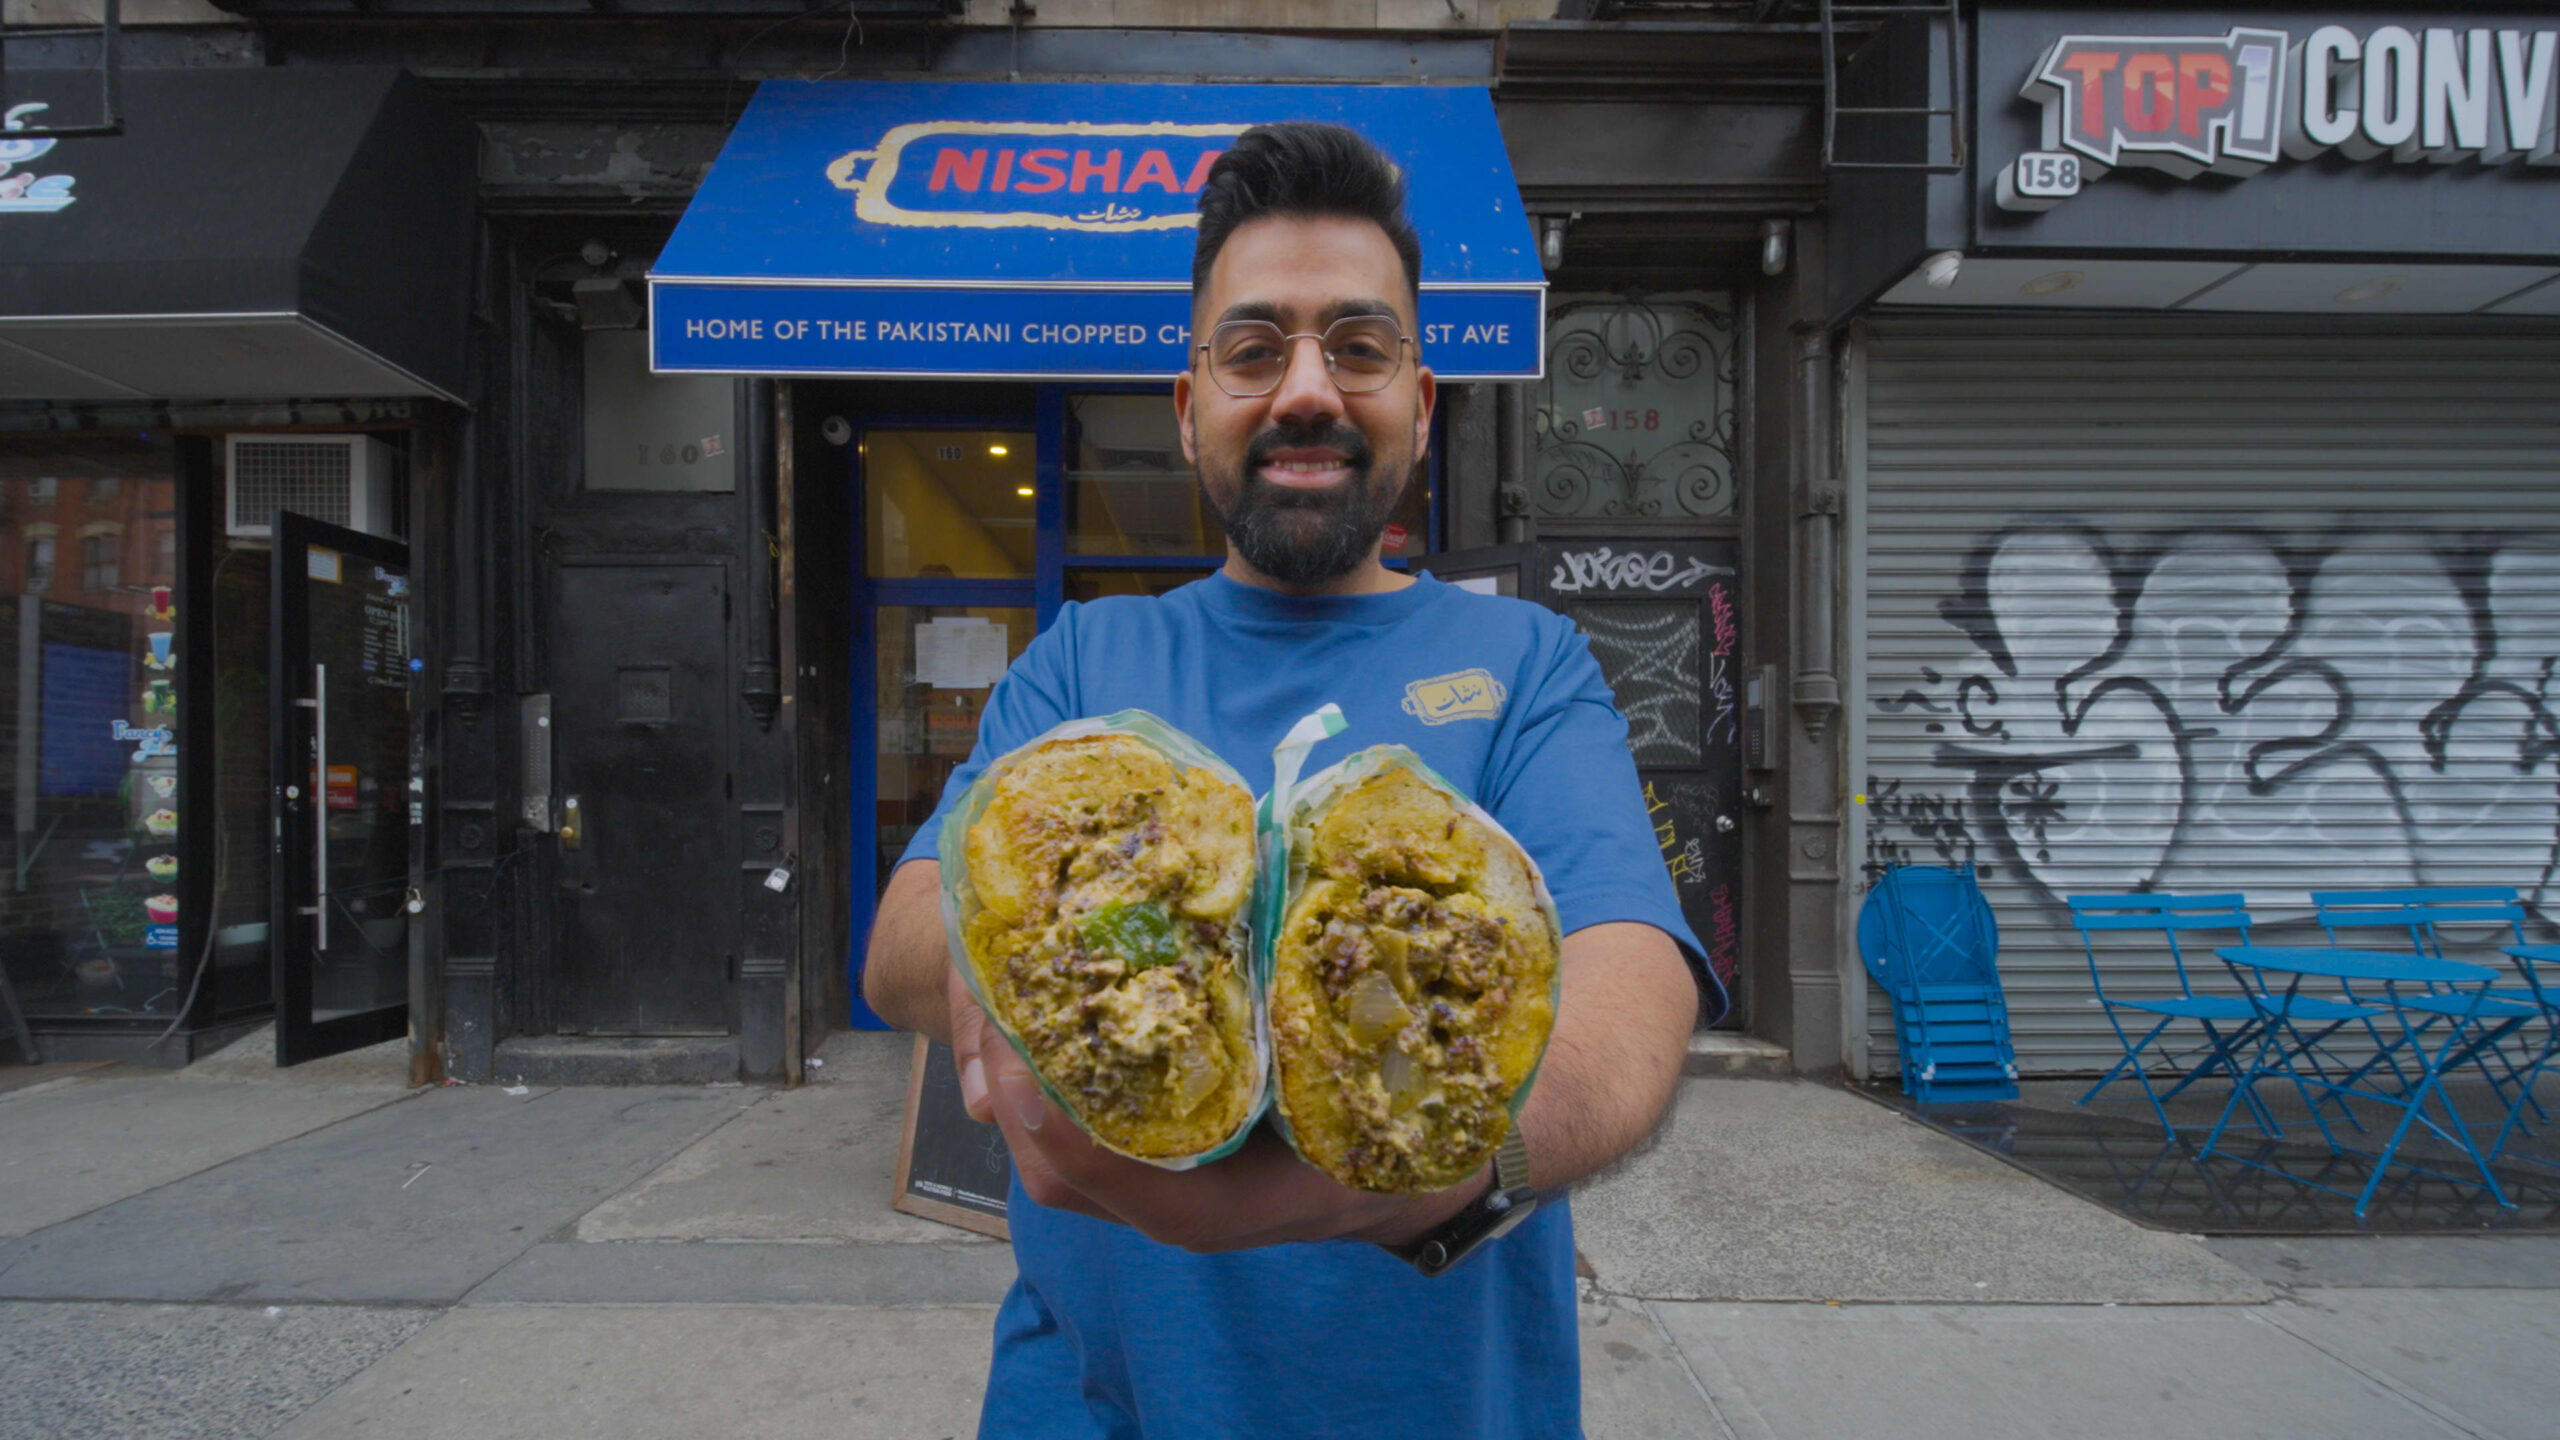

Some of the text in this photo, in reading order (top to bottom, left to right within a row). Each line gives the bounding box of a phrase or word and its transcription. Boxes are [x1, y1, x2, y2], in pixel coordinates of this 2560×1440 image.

[2303, 25, 2558, 150] CONV
[2021, 157, 2078, 189] 158
[686, 319, 764, 340] HOME
[774, 320, 809, 340] OF
[816, 320, 867, 341] THE
[877, 321, 1010, 342] PAKISTANI
[1021, 323, 1147, 344] CHOPPED
[1424, 323, 1510, 344] ST AVE
[1609, 408, 1660, 431] 158
[638, 443, 699, 465] 160
[939, 447, 961, 460] 160
